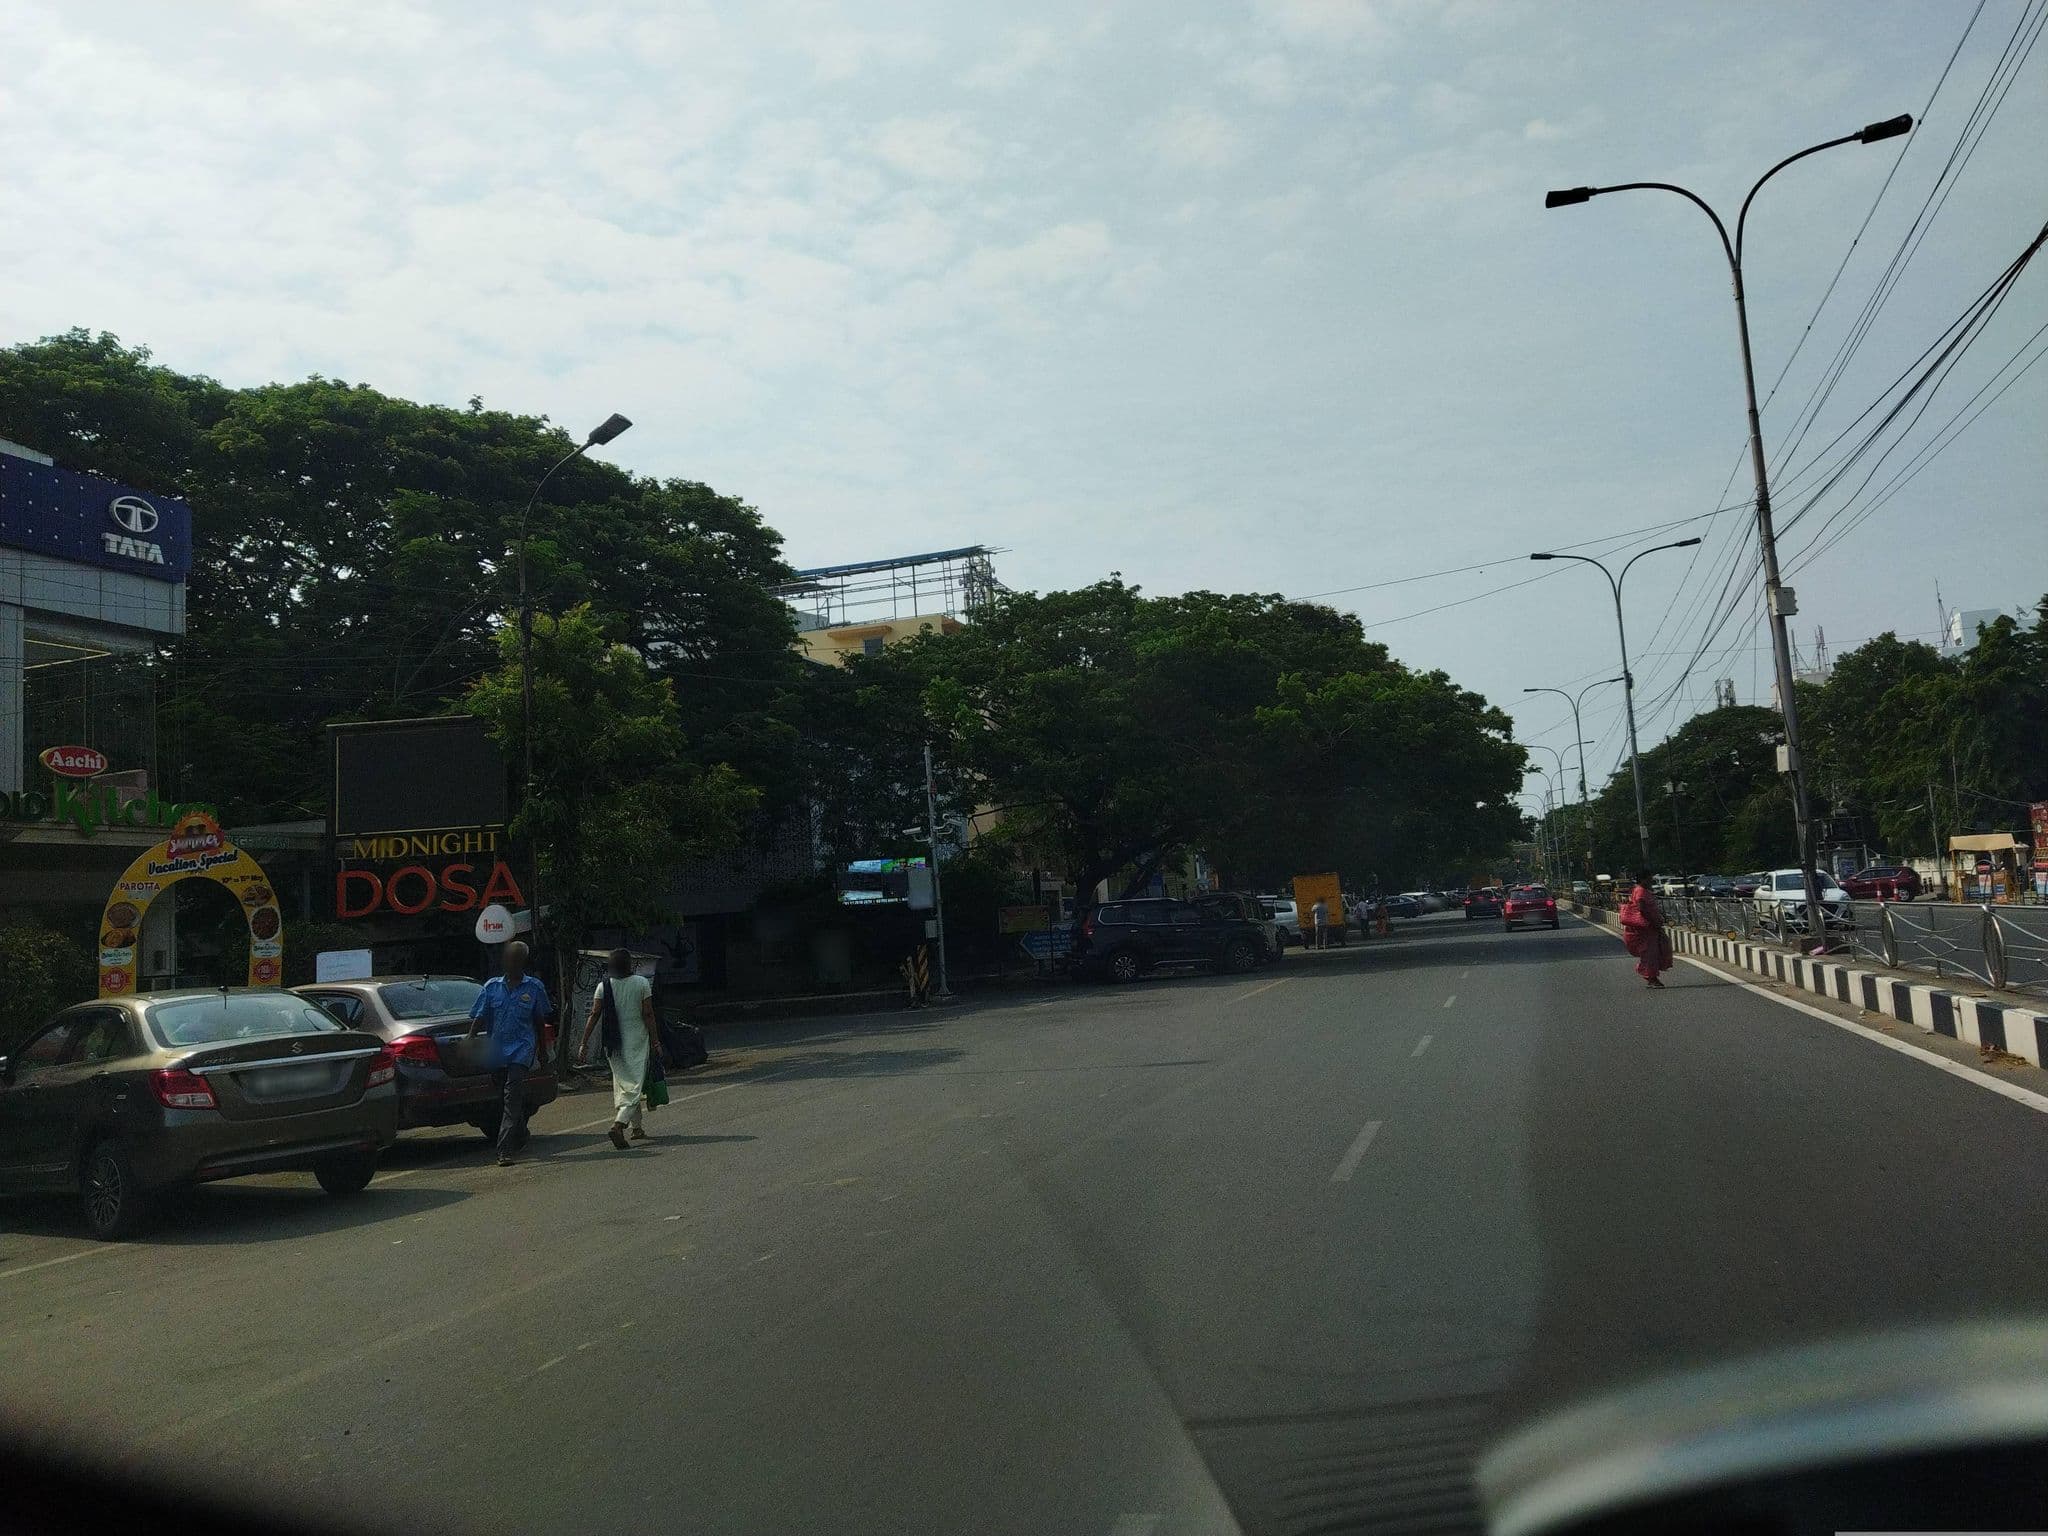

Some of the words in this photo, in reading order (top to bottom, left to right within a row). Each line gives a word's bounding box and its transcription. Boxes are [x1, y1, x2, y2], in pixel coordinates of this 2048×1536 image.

[101, 532, 165, 565] TATA
[50, 751, 102, 769] Aachi
[353, 832, 499, 859] MIDNIGHT
[148, 859, 197, 875] Vacation
[199, 850, 238, 869] Special
[120, 882, 161, 891] PAROTTA
[335, 859, 527, 919] DOSA
